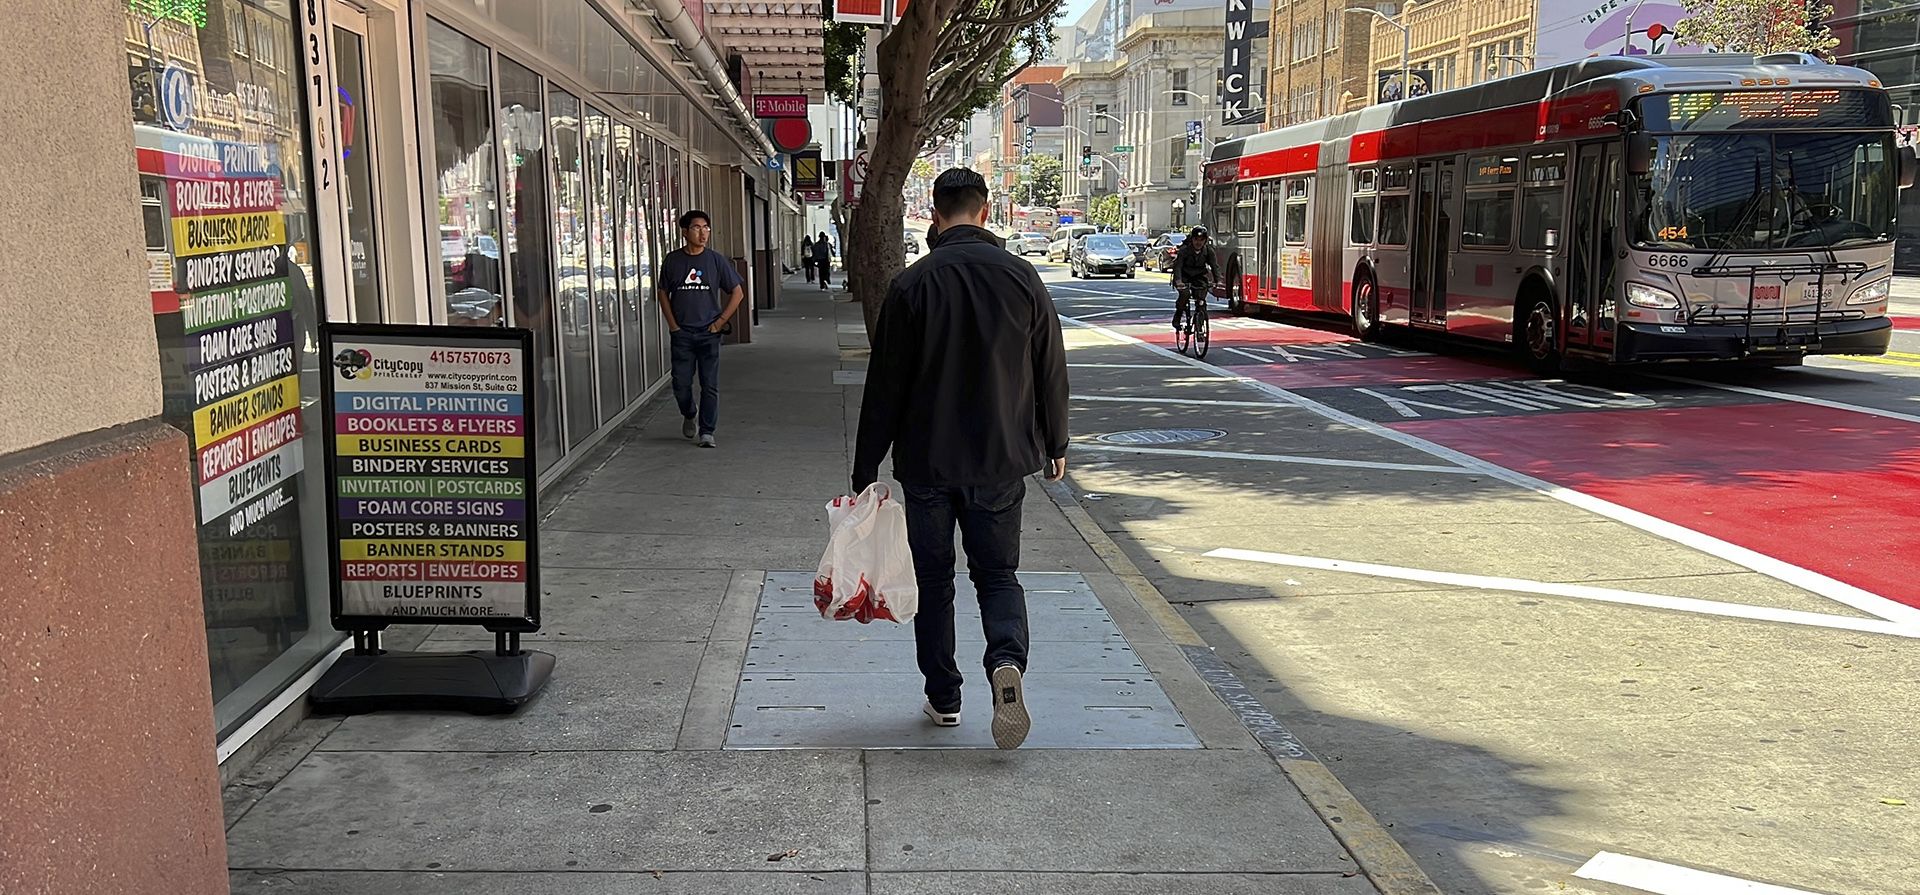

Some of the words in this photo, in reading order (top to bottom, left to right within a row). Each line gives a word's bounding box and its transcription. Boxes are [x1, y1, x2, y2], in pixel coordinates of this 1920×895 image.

[768, 100, 806, 112] Mobile
[179, 143, 222, 173] DIGITAL
[224, 144, 269, 173] PRINTING
[176, 181, 231, 211] BOOKLETS
[234, 181, 241, 208] &
[243, 180, 275, 208] FLYERS
[188, 217, 238, 249] BUSINESS
[240, 215, 270, 243] CARDS
[1658, 226, 1688, 239] 454
[186, 252, 232, 290] BINDERY
[234, 247, 276, 282] SERVICES
[1649, 254, 1689, 268] 6666
[183, 291, 233, 330] INVITATION
[240, 281, 286, 316] POSTCARDS
[200, 330, 228, 364] FOAM
[229, 323, 253, 356] CORE
[253, 317, 277, 349] SIGNS
[430, 350, 511, 365] 4157570673
[373, 358, 424, 374] CityCopy
[195, 363, 240, 405] POSTERS
[241, 359, 250, 388] &
[251, 346, 293, 384] BANNERS
[427, 372, 517, 382] www.citycopyprint.com
[424, 382, 439, 390] 837
[440, 382, 471, 391] Mission
[485, 383, 504, 391] Suite
[506, 384, 518, 392] G2
[352, 396, 422, 411] DIGITAL
[426, 396, 508, 413] PRINTING
[1353, 379, 1657, 418] ONLY
[210, 396, 250, 437] BANNER
[251, 383, 284, 420] STANDS
[347, 417, 438, 433] BOOKLETS
[441, 418, 454, 432] &
[457, 419, 517, 434] FLYERS
[202, 435, 243, 481] REPORTS
[251, 412, 297, 457] ENVELOPES
[359, 439, 441, 453] BUSINESS
[445, 440, 502, 454] CARDS
[352, 458, 427, 473] BINDERY
[431, 459, 509, 474] SERVICES
[228, 453, 282, 505] BLUEPRINTS
[341, 479, 427, 494] INVITATION
[437, 479, 523, 495] POSTCARDS
[358, 500, 407, 515] FOAM
[411, 500, 453, 516] CORE
[457, 501, 505, 516] SIGNS
[229, 510, 246, 537] AND
[245, 498, 266, 527] MUCH
[352, 522, 425, 537] POSTERS
[428, 522, 441, 537] &
[444, 523, 519, 538] BANNERS
[367, 543, 436, 557] BANNER
[440, 543, 505, 558] STANDS
[346, 563, 418, 577] REPORTS
[429, 563, 518, 579] ENVELOPES
[383, 585, 483, 599] BLUEPRINTS
[391, 606, 417, 616] AND
[420, 606, 456, 616] MUCH
